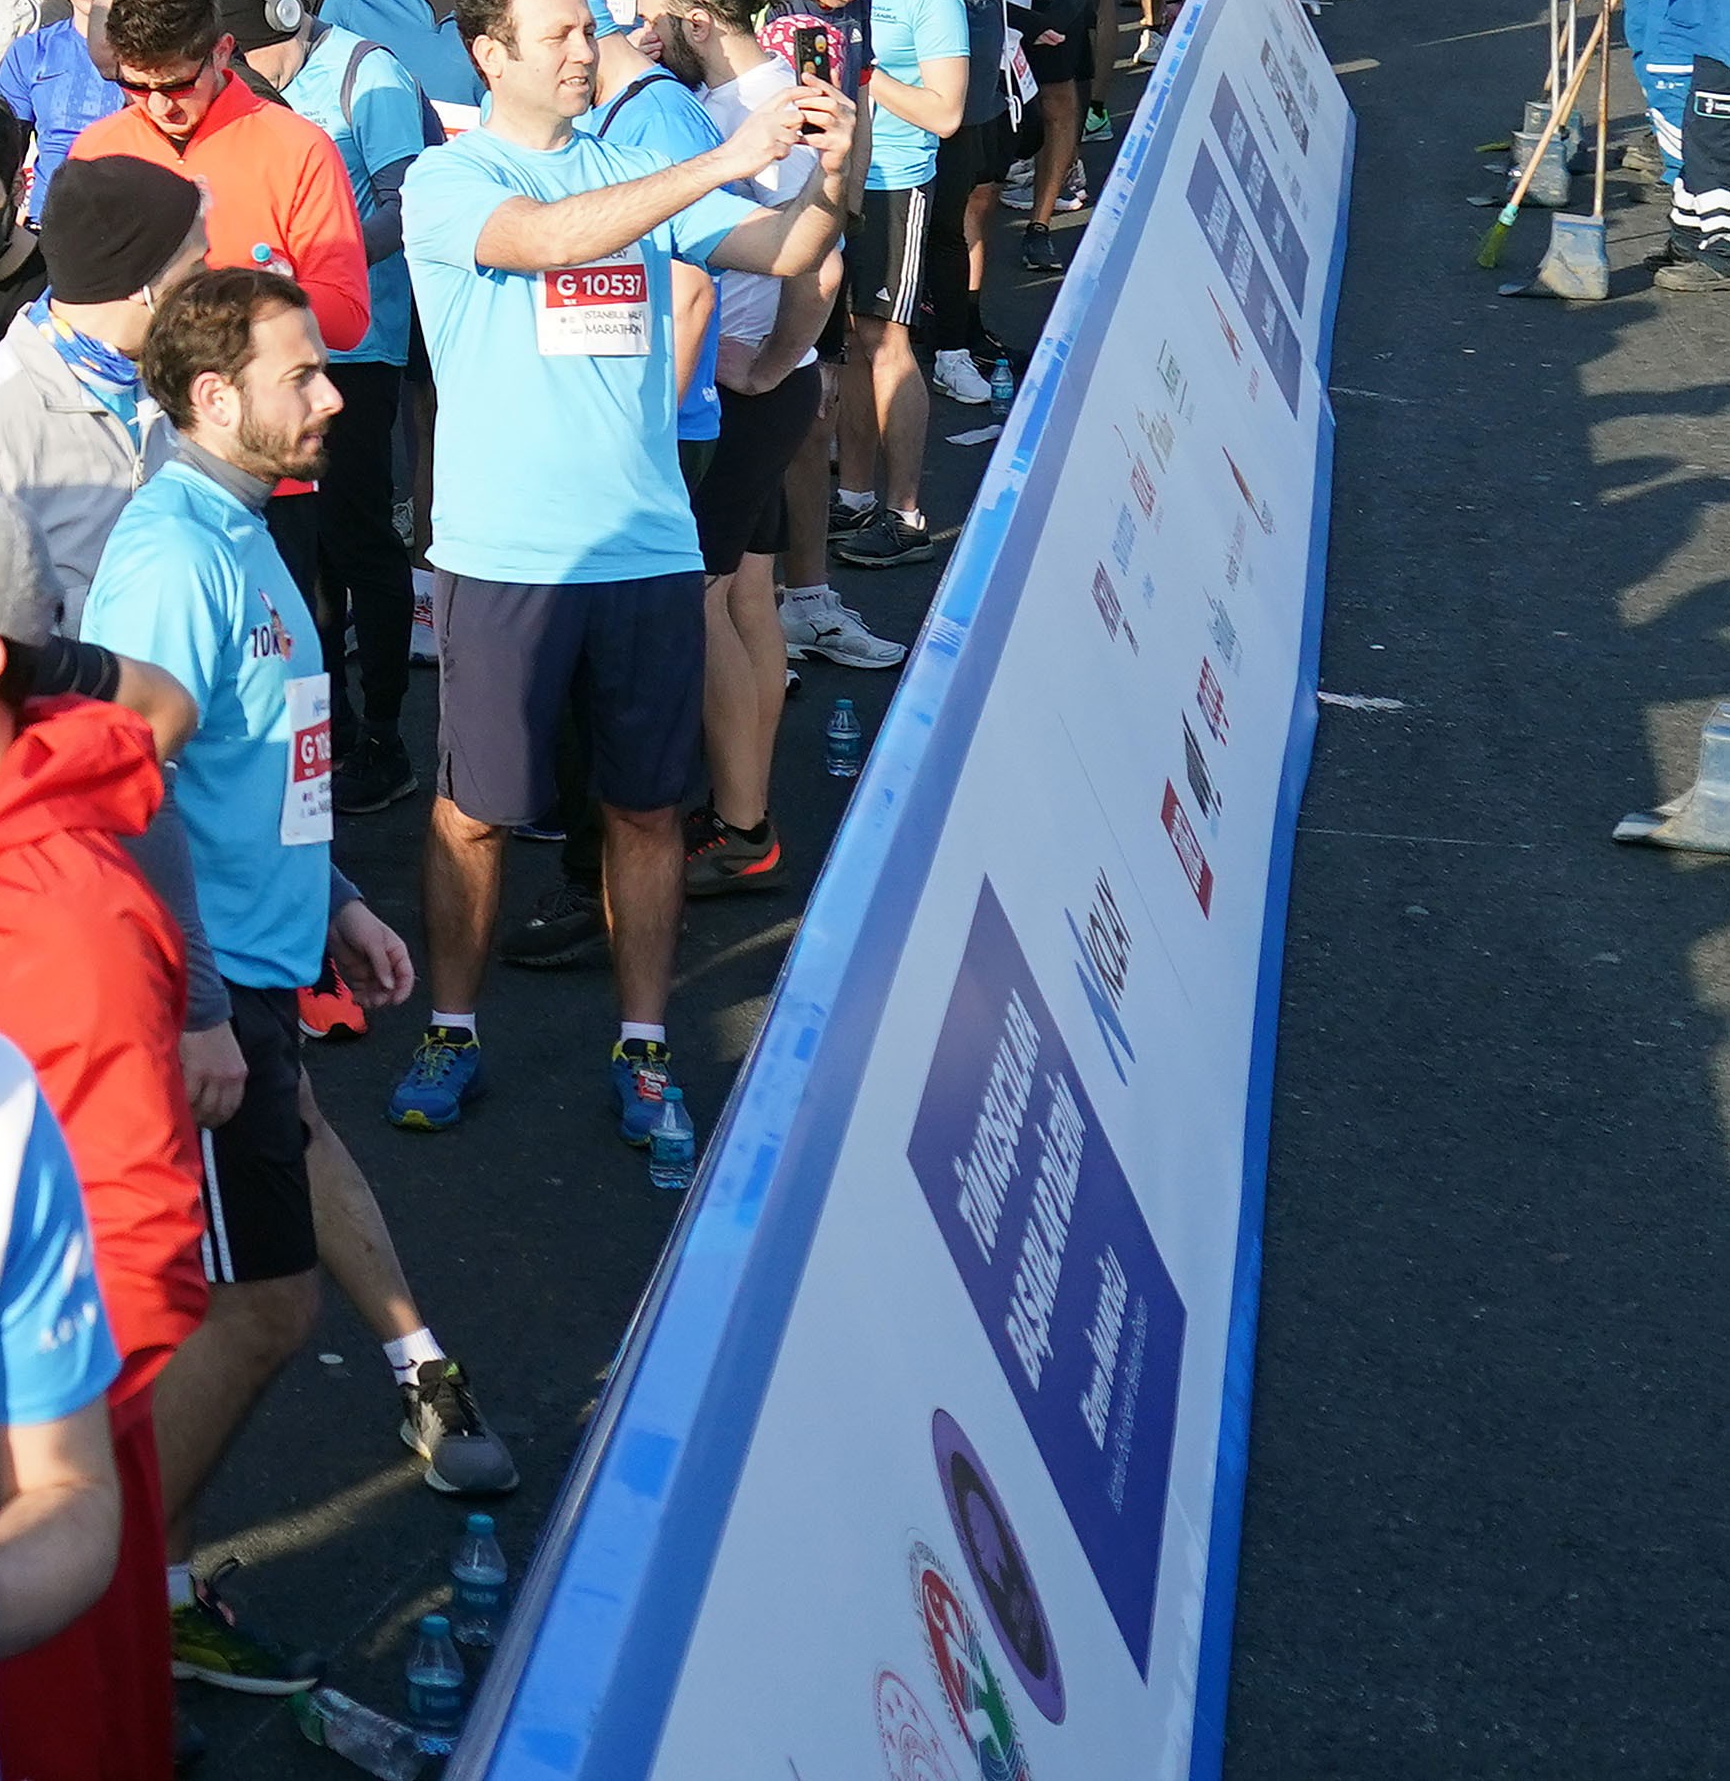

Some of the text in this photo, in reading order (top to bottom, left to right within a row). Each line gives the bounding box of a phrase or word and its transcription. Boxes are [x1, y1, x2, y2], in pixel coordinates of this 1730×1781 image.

[556, 273, 642, 297] G 10537
[300, 733, 315, 764] G
[1085, 865, 1133, 1012] KOLAY
[974, 986, 1042, 1178] KOŞUCULARA
[1006, 1068, 1087, 1392] BAŞARILAR DİLERİM
